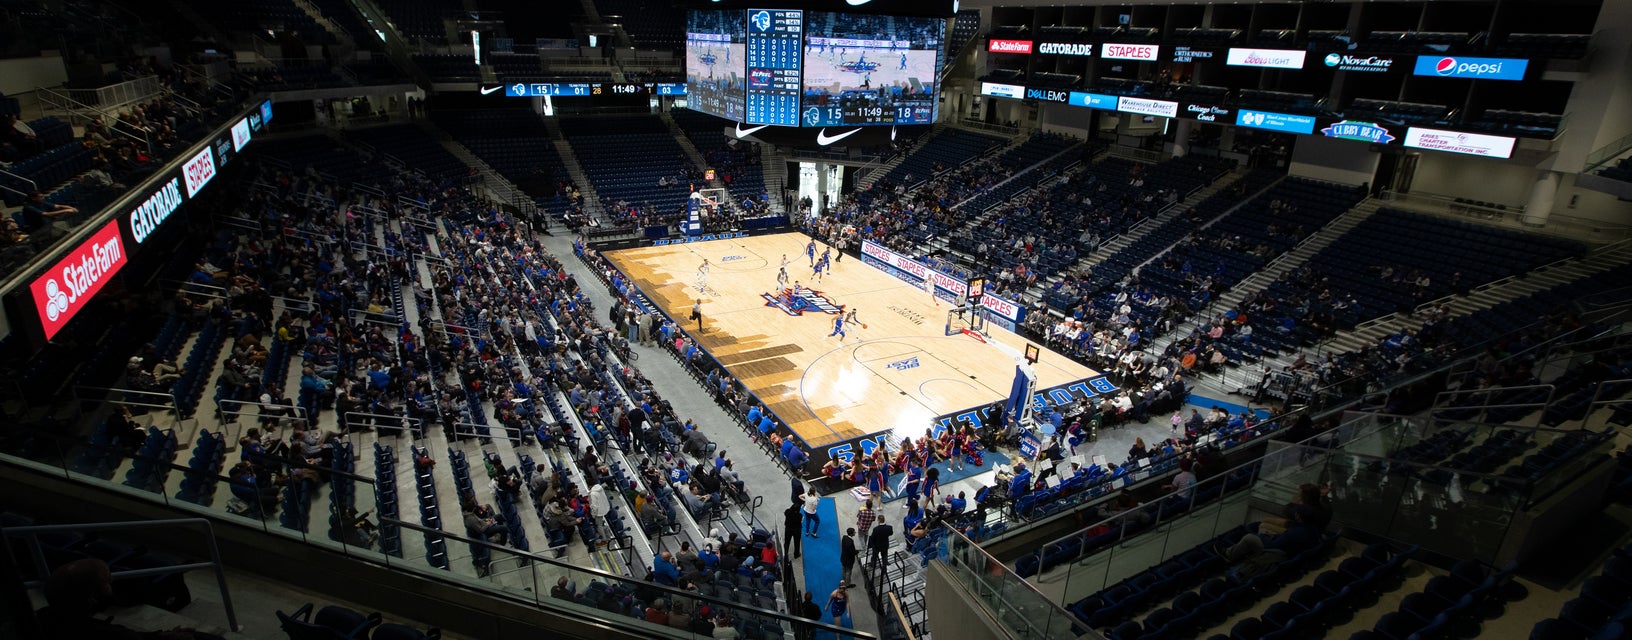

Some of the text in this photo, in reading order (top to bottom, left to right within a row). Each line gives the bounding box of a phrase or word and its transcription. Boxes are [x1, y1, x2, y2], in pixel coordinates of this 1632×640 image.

[1039, 42, 1093, 56] GATORADE
[1108, 46, 1151, 59] STAPLES
[1268, 57, 1290, 65] LIGHT
[1339, 55, 1393, 67] NovaCare
[1457, 62, 1503, 75] pepsi
[537, 86, 548, 94] 15
[592, 87, 602, 95] 28
[612, 85, 635, 93] 11:49
[726, 102, 733, 113] 18
[858, 107, 882, 117] 11:49
[1152, 102, 1172, 110] DIRECT
[828, 108, 842, 119] 15
[898, 108, 911, 118] 18
[1197, 113, 1216, 122] Coach
[1333, 124, 1382, 140] CUBBY BEAR
[1418, 142, 1474, 153] TRANSPORTATION
[188, 152, 213, 191] STAPLES
[130, 177, 182, 244] GATORADE
[864, 244, 890, 262] STAPLES
[897, 257, 925, 278] STAPLES
[934, 274, 966, 295] STAPLES
[981, 294, 1012, 316] TAPLES
[1033, 377, 1120, 413] BLUE
